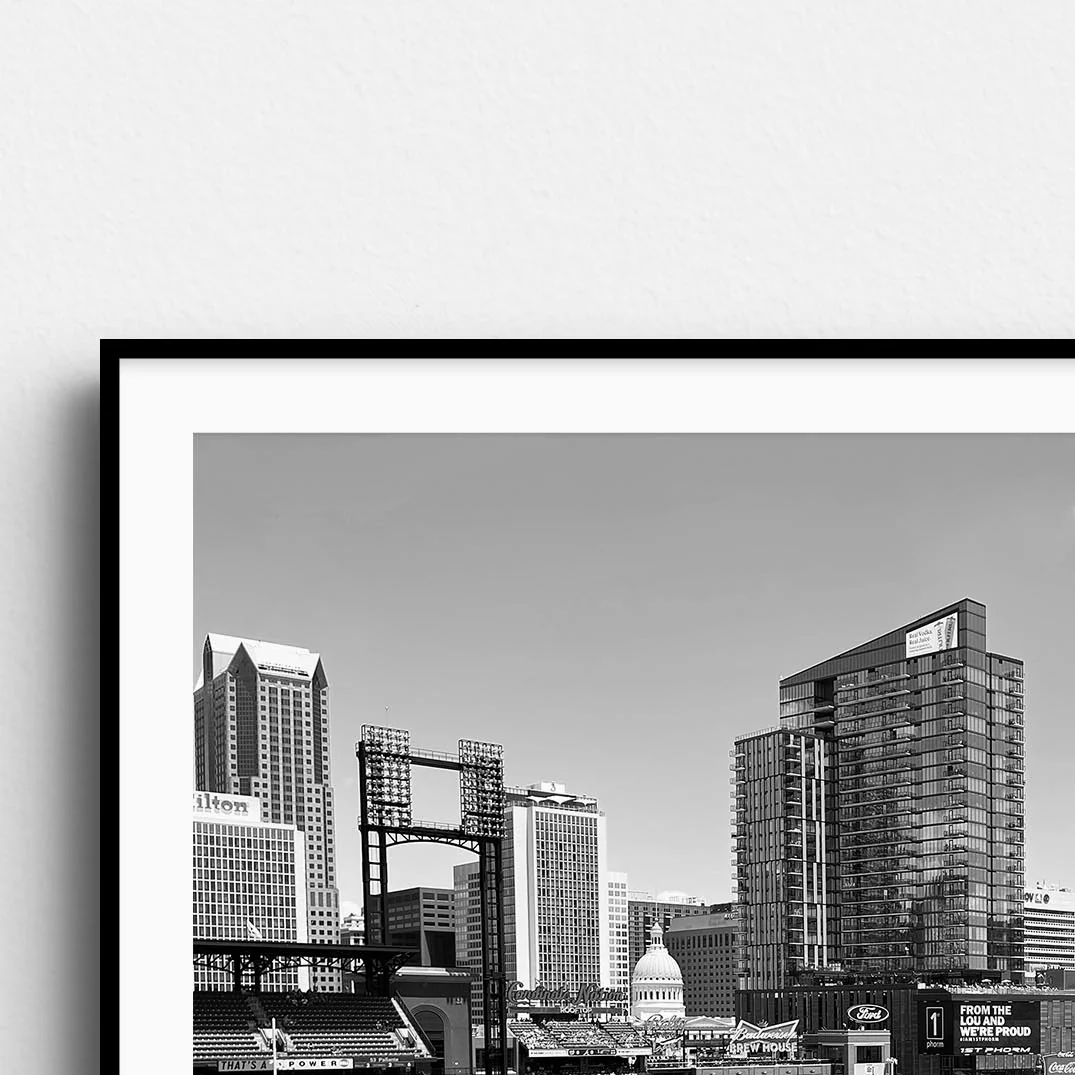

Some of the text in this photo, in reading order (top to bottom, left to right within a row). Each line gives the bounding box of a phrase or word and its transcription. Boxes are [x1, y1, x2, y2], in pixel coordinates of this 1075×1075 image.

[193, 793, 248, 812] ilton
[508, 981, 625, 1005] Cardinals Nation
[856, 1006, 882, 1020] Ford
[960, 1005, 1012, 1015] FROM THE
[960, 1016, 1005, 1026] LOU AND
[728, 1027, 797, 1040] Budweiser
[960, 1026, 1032, 1037] WE'RE PROUD
[730, 1042, 798, 1053] BREW HOUSE
[926, 1040, 944, 1049] phorm
[221, 1060, 268, 1071] THAT'S A
[289, 1059, 337, 1067] POWER
